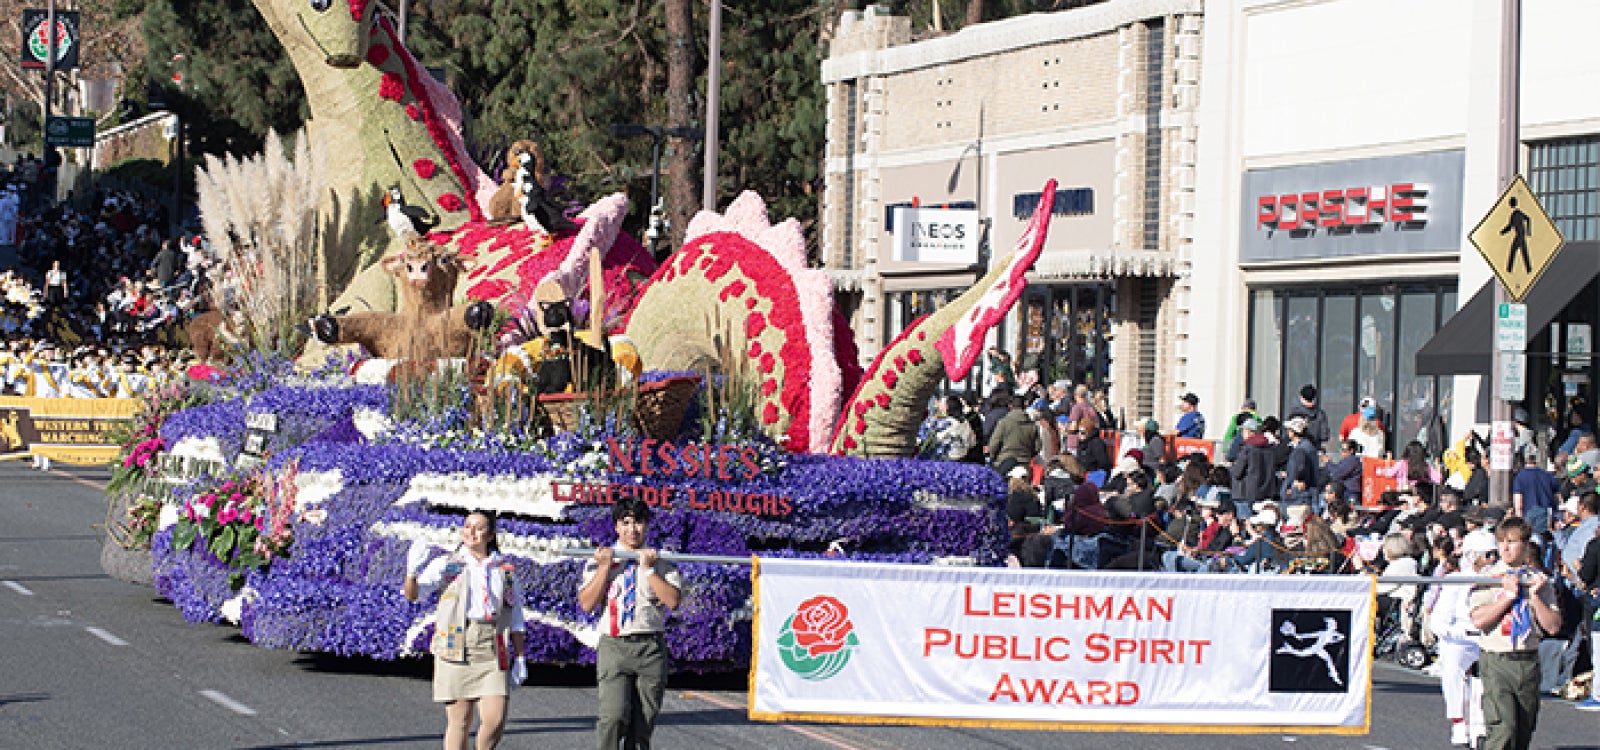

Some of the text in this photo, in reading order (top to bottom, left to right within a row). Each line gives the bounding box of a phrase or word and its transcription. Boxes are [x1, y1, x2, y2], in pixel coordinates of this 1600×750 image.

[1257, 183, 1429, 231] PORSCHE
[911, 221, 966, 239] INEOS
[550, 481, 792, 516] LAKESIDE LAUGHS
[963, 585, 1174, 622] LEISHMAN
[923, 626, 1212, 665] PUBLIC SPIRIT
[988, 672, 1140, 706] AWARD
